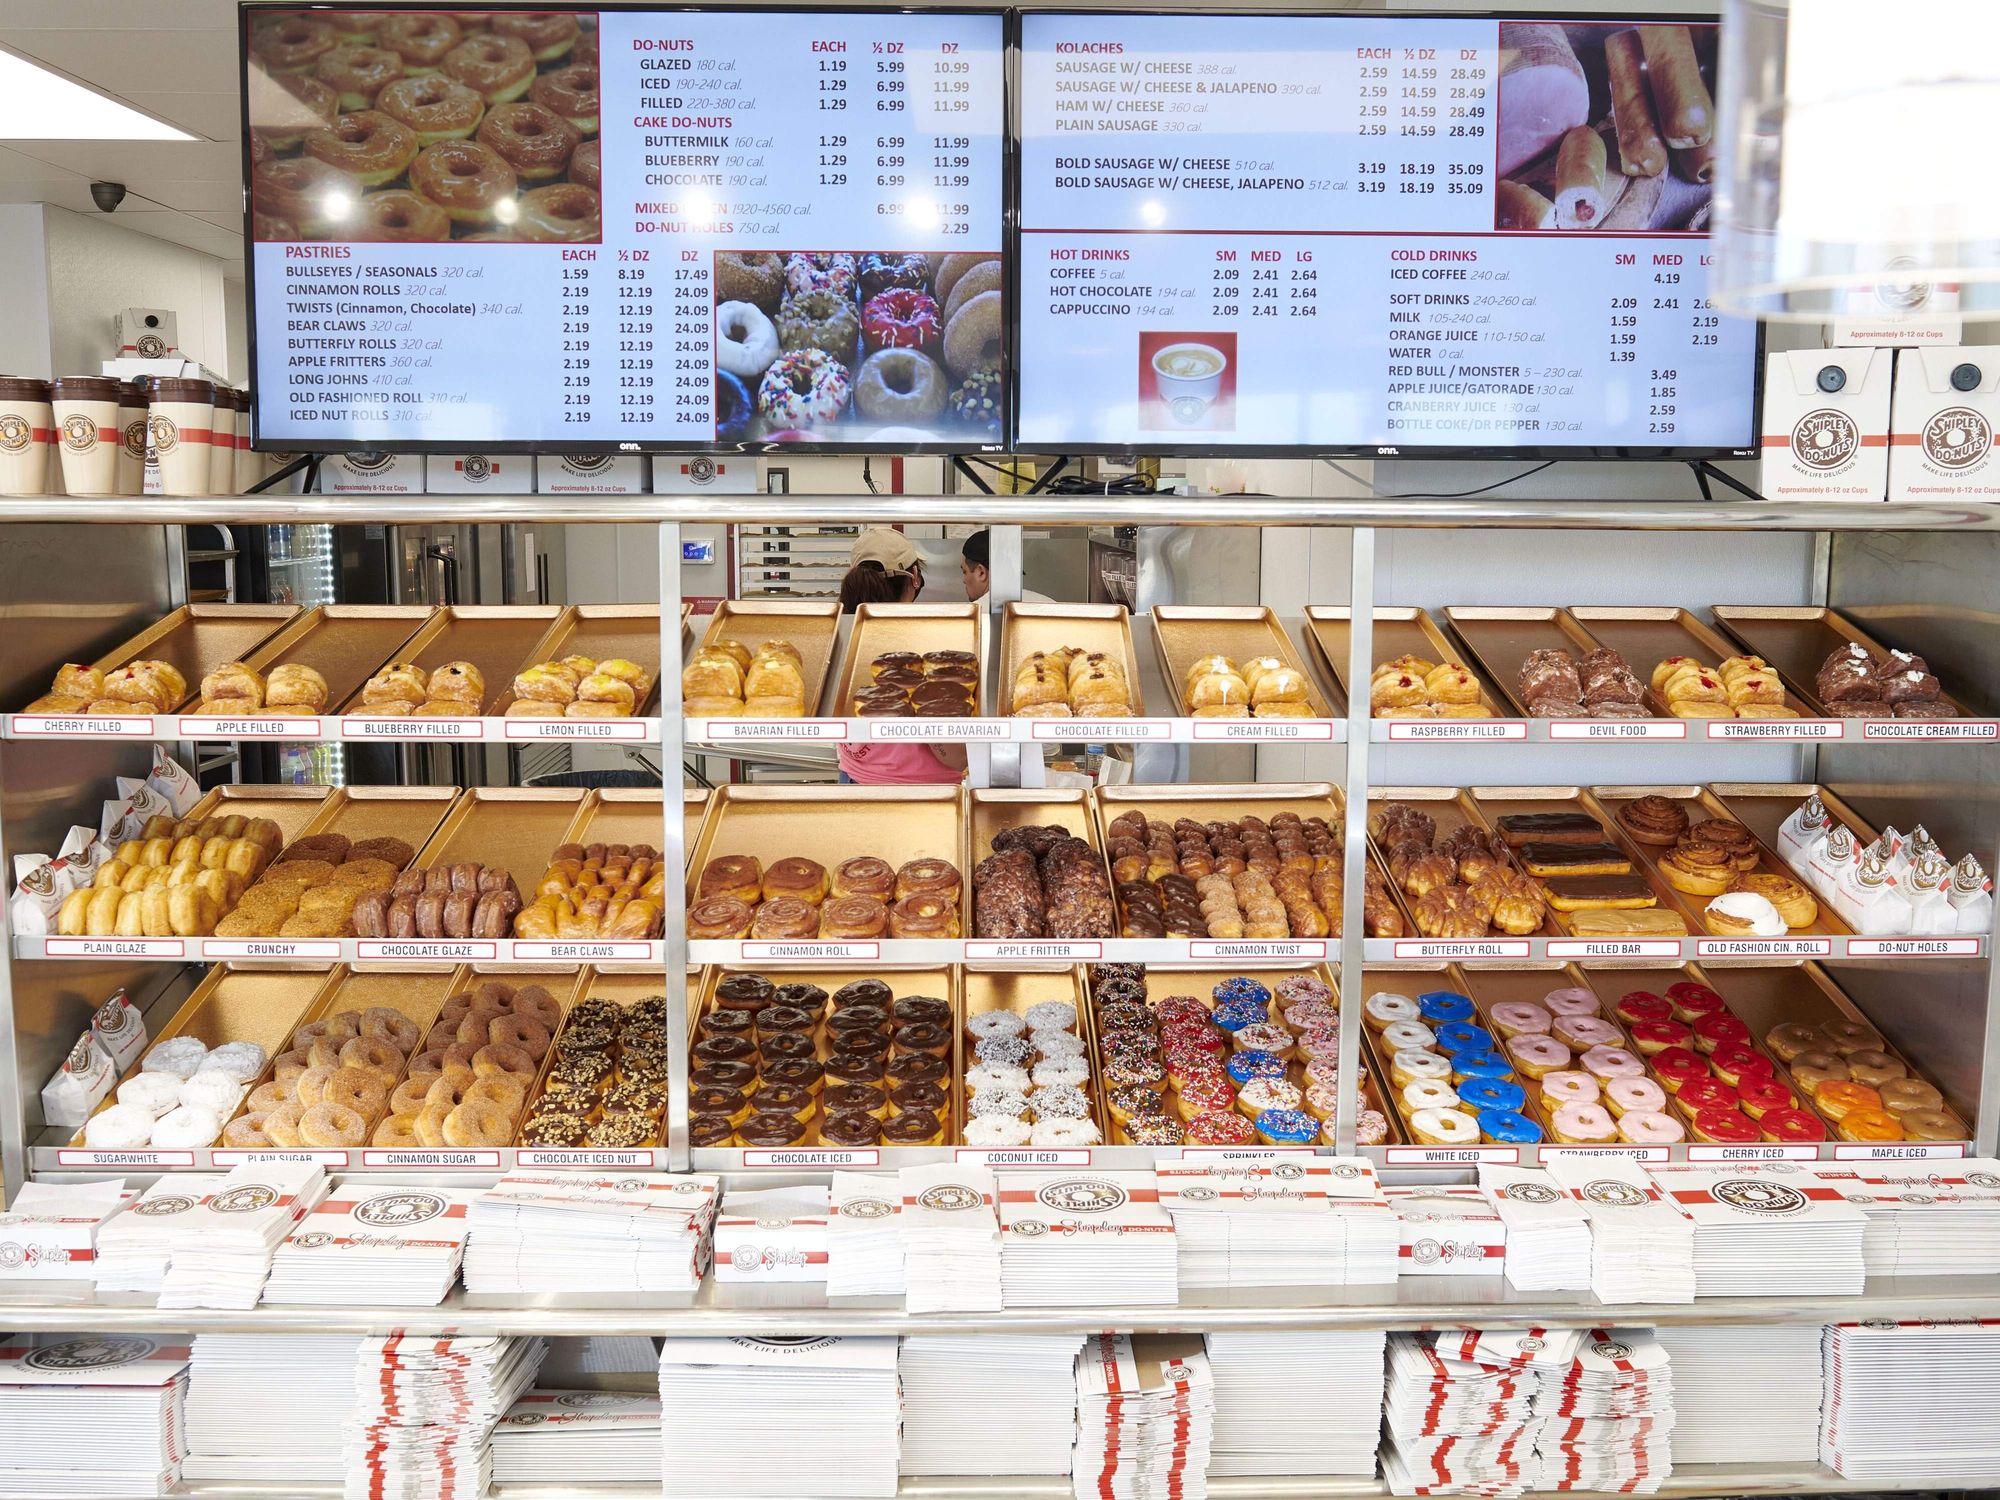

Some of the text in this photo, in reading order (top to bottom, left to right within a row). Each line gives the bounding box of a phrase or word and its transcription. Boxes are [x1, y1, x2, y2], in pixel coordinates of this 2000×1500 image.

[633, 39, 694, 51] DO-NUTS
[811, 40, 847, 53] EACH
[886, 42, 905, 54] DZ
[941, 42, 960, 54] DZ
[1055, 42, 1124, 54] KOLACHES
[640, 58, 905, 73] GLAZED 1.19 5.99
[640, 77, 671, 90] ICED
[640, 97, 683, 109] FILLED
[633, 116, 733, 129] CAKE DO-NUTS
[644, 135, 729, 148] BUTTERMILK
[645, 154, 720, 167] BLUEBERRY
[1055, 156, 1484, 176] BOLD SAUSAGE W/ CHEESE 3.19 18.19 35.09
[644, 173, 724, 186] CHOCOLATE
[285, 245, 597, 261] PASTRIES EACH
[1050, 248, 1313, 263] HOT DRINKS SM MED LG
[1390, 249, 1478, 262] COLD DRINKS
[286, 264, 709, 281] BULLSEYES / SEASONALS 1.59 8.19 17.49
[1049, 267, 1318, 281] COFFEE 2.09 2.41 2.64
[1390, 268, 1681, 285] ICED COFFEE 4.19
[286, 284, 401, 296] CINNAMON ROLLS
[1050, 285, 1153, 298] HOT CHOCOLATE
[1389, 293, 1470, 306] SOFT DRINKS
[285, 301, 477, 317] TWISTS (Cinnamon, Chocolate)
[1049, 303, 1131, 316] CAPPUCCINO
[1389, 311, 1421, 323] MILK
[287, 319, 367, 332] BEAR CLAWS
[288, 338, 397, 350] BUTTERFLY ROLLS
[1388, 347, 1432, 359] WATER
[287, 355, 387, 368] APPLE FRITTERS
[1388, 364, 1520, 379] RED BULL / MONSTER
[288, 373, 369, 385] LONG JOHNS
[1800, 419, 1848, 438] SHIPLEY
[1930, 417, 1981, 437] SHIPLEY
[1791, 460, 1857, 479] MAKE LIFE DELICIOUS
[1777, 486, 1825, 495] Approximately
[1851, 486, 1869, 495] Cups
[44, 720, 122, 732] CHERRY FILLED
[215, 722, 285, 733] APPLE FILLED
[364, 723, 461, 735] BLUEBERRY FILLED
[539, 724, 612, 736] LEMON FILLED
[734, 725, 821, 736] BAVARIAN FILLED
[879, 725, 1002, 737] CHOCOLATE BAVARIAN
[1054, 725, 1149, 736] CHOCOLATE FILLED
[1226, 726, 1299, 737] CREAM FILLED
[1410, 726, 1506, 737] RASPBERRY FILLED
[1589, 725, 1649, 736] DEVIL FOOD
[1724, 725, 1827, 736] STRAWBERRY FILLED
[1867, 725, 1995, 737] CHOCOLATE CREAM FILLED
[83, 942, 147, 954] PLAIN GLAZE
[246, 944, 297, 955] CRUNCHY
[381, 945, 473, 956] CHOCOLATE GLAZE
[551, 946, 614, 957] BEAR CLAWS
[769, 945, 851, 956] CINNAMON ROLL
[996, 945, 1073, 956] APPLE FRITTER
[1214, 944, 1302, 955] CINNAMON TWIST
[1421, 944, 1504, 955] BUTTERFLY ROLL
[1586, 944, 1641, 954] FILLED BAR
[1707, 942, 1821, 953] OLD FASHION CIN. ROLL
[1878, 942, 1949, 953] DO-NUT HOLES
[93, 1153, 159, 1164] SUGARWHITE
[386, 1154, 477, 1164] CINNAMON SUGAR
[533, 1153, 638, 1164] CHOCOLATE ICED NUT
[770, 1153, 852, 1164] CHOCOLATE ICED
[986, 1152, 1059, 1163] COCONUT ICED
[1425, 1151, 1481, 1161] WHITE ICED
[1722, 1148, 1785, 1159] CHERRY ICED
[1871, 1148, 1928, 1159] MAPLE ICED
[1720, 1183, 1781, 1196] SHIPLEY
[1443, 1239, 1485, 1264] Shipley
[764, 1245, 807, 1271] Shipley
[754, 1335, 843, 1355] LIFE DELICIOUS
